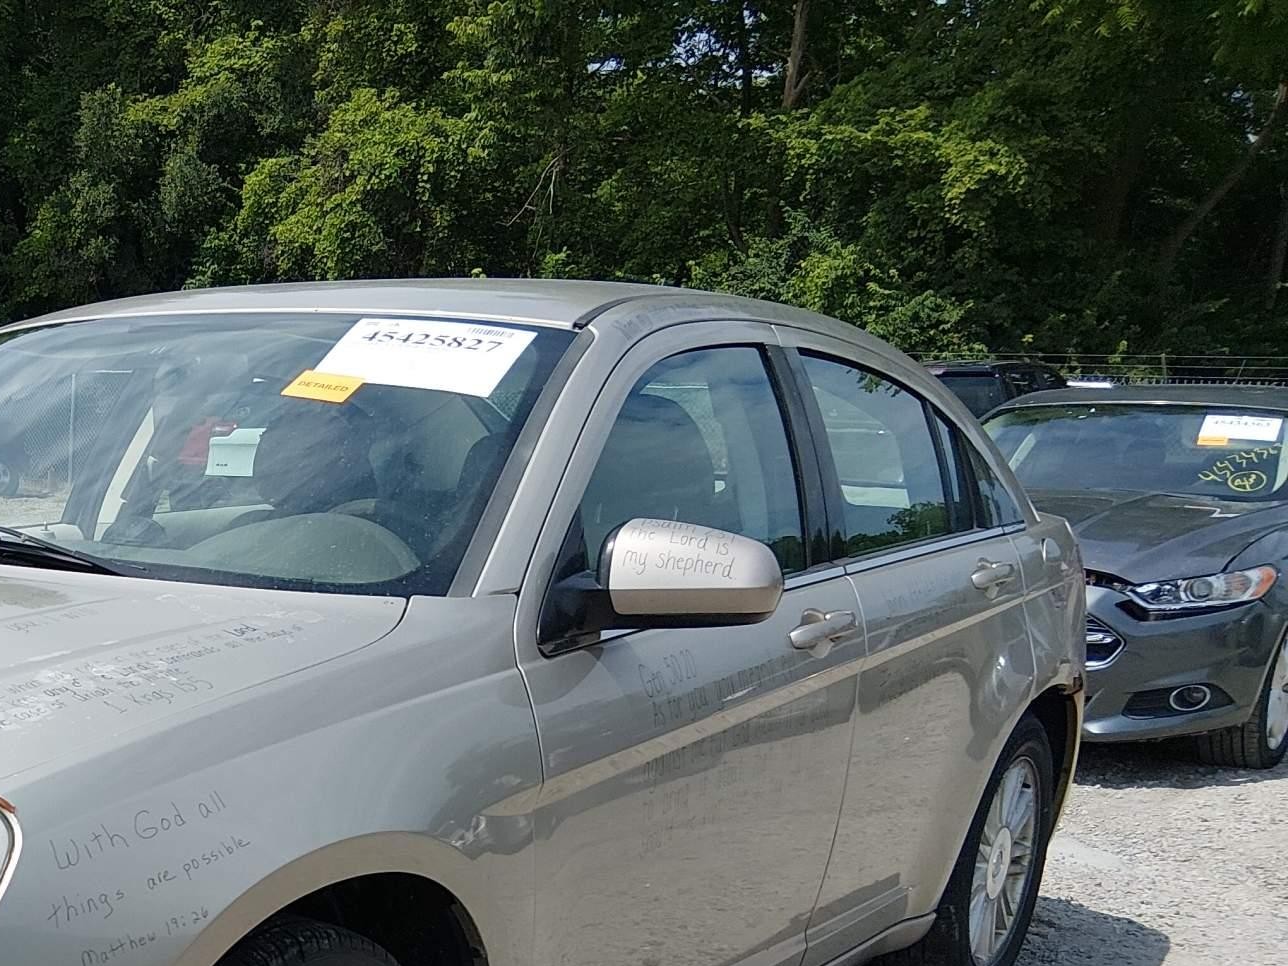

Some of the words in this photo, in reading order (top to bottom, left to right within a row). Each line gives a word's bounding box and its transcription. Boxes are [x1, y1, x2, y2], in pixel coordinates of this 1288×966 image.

[363, 329, 503, 352] 45425827
[297, 380, 349, 392] DETAILED
[669, 531, 709, 551] Lord
[622, 549, 650, 576] my
[48, 823, 131, 870] With
[133, 801, 186, 840] God
[198, 789, 228, 819] all
[47, 888, 126, 929] things
[145, 869, 178, 891] are
[181, 835, 251, 882] possible
